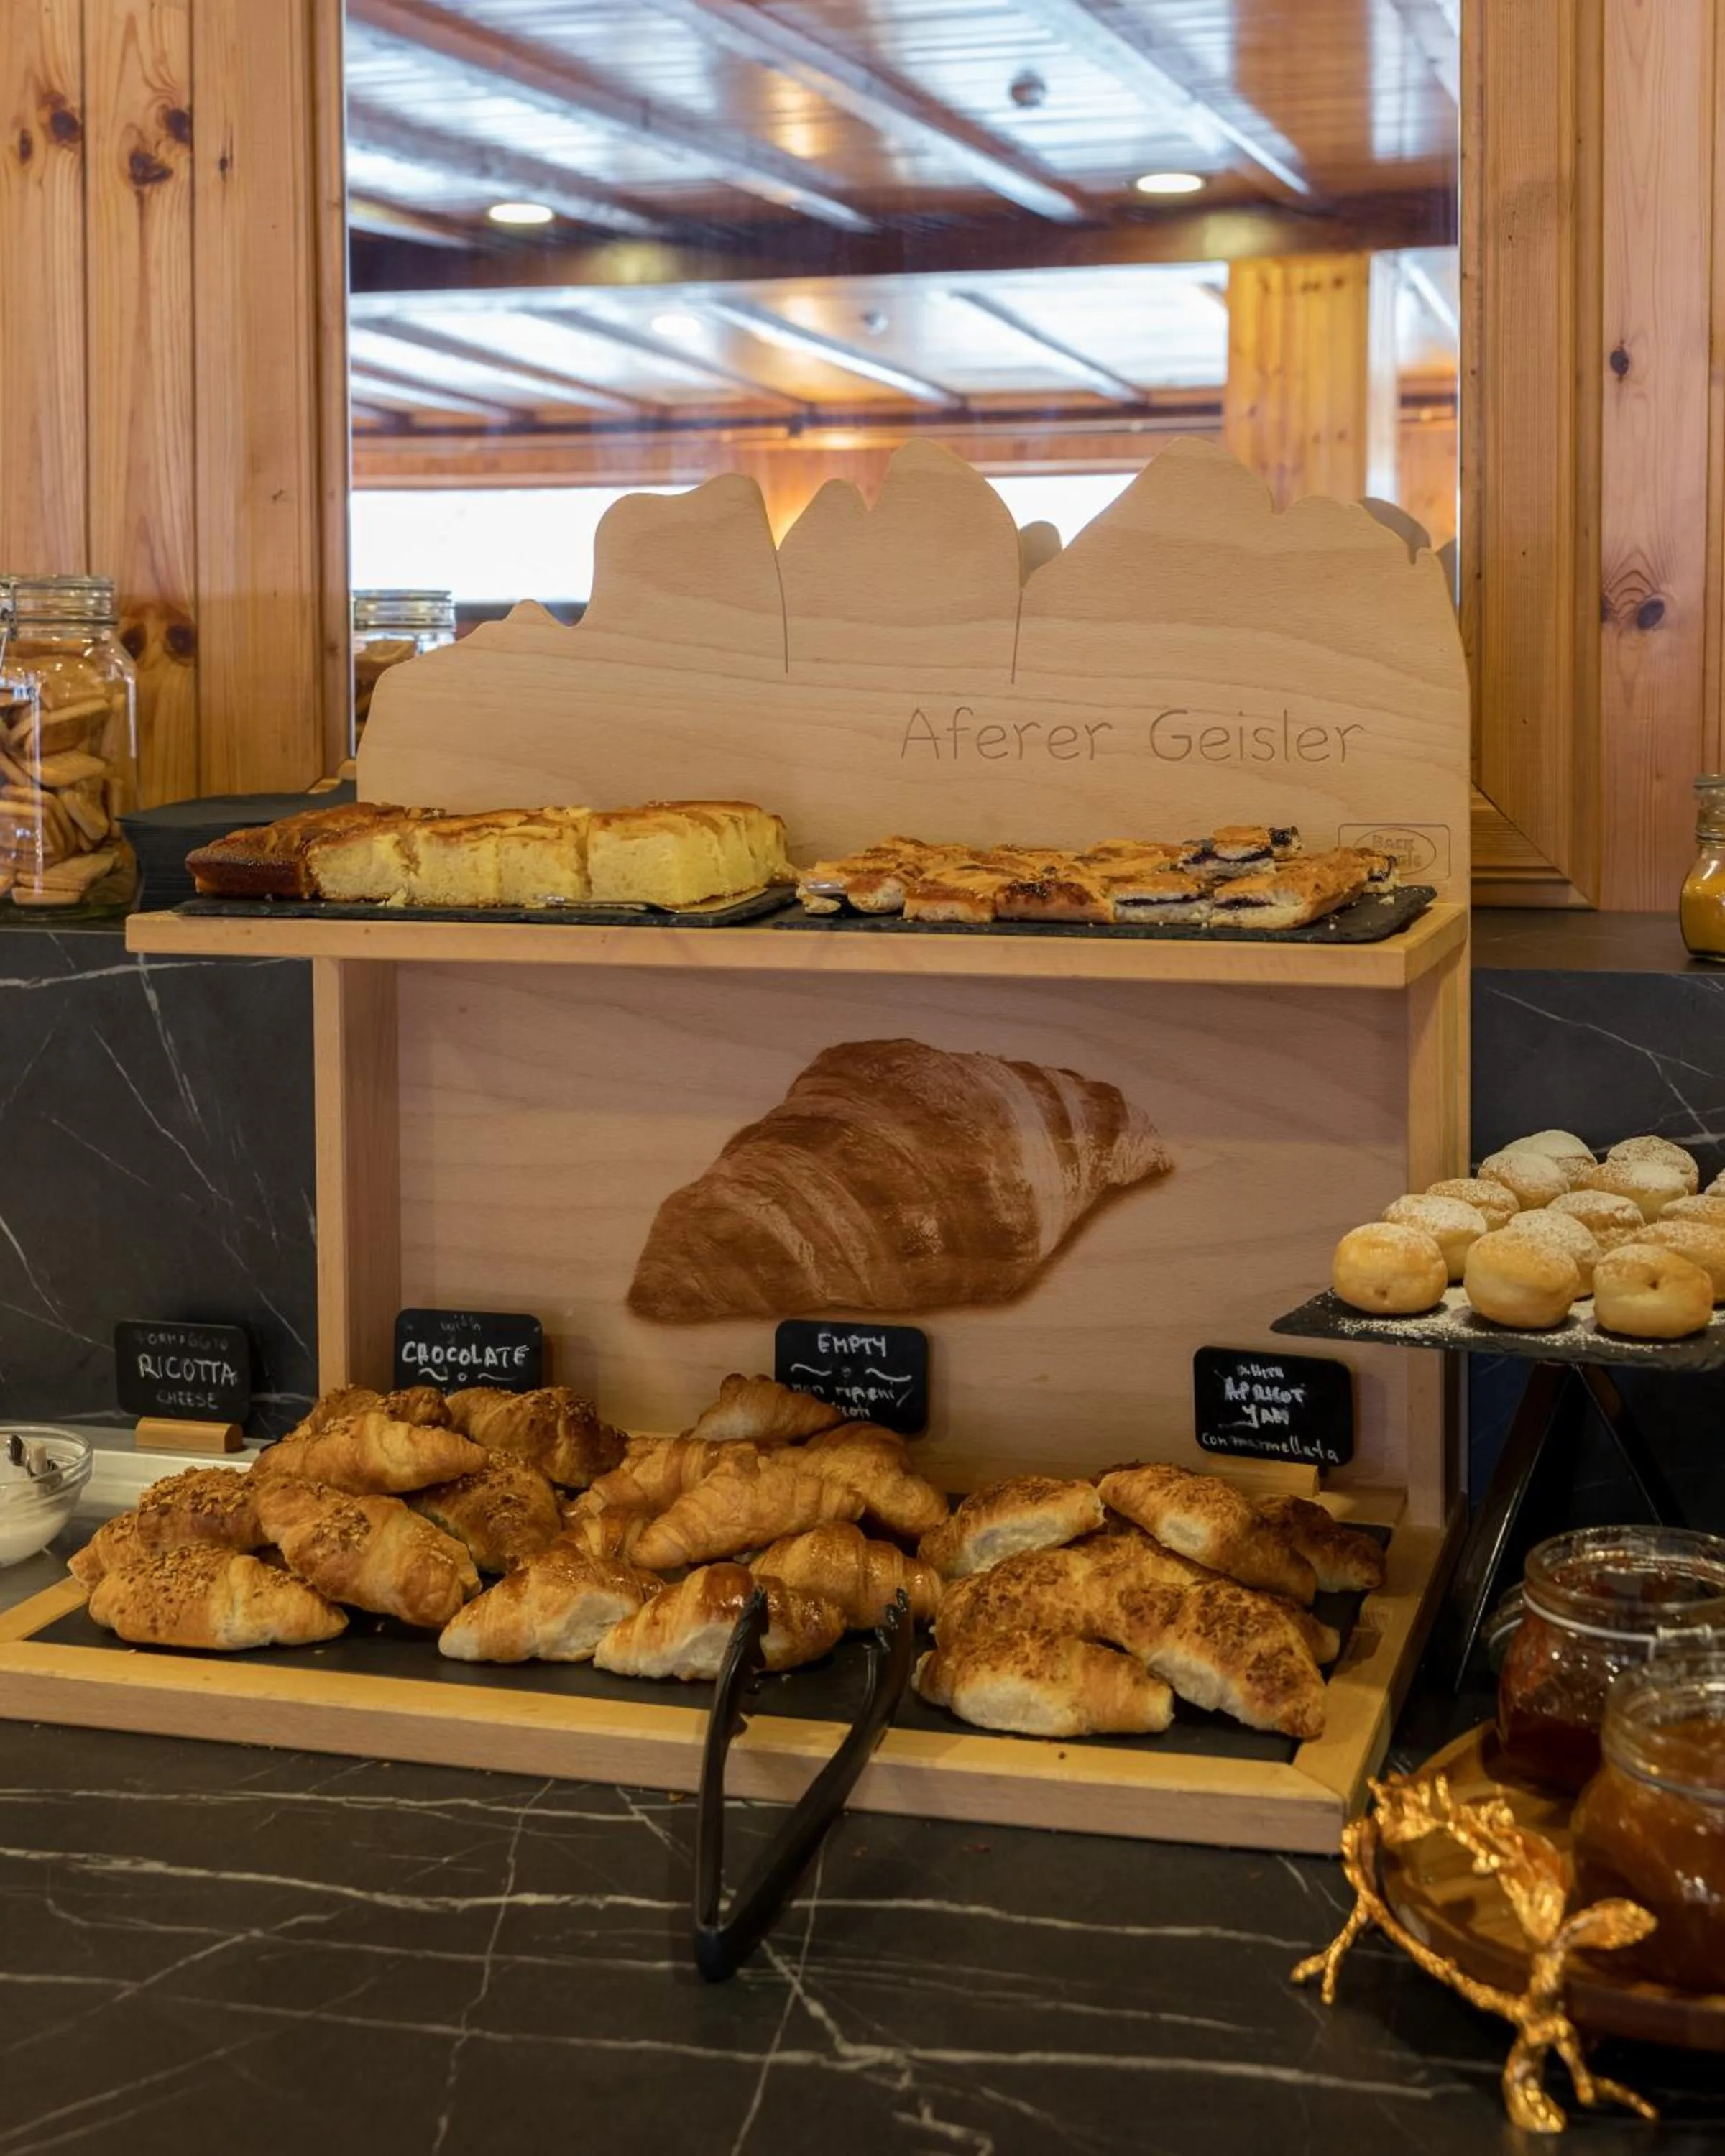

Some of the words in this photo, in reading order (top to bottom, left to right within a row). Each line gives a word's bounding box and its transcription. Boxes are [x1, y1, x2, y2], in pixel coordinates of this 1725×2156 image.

[900, 706, 1113, 760] Aferer
[1151, 709, 1365, 763] Geisler
[817, 1333, 887, 1357] EMPTY
[138, 1353, 238, 1386] RICOTTA
[156, 1389, 218, 1409] CHEESE
